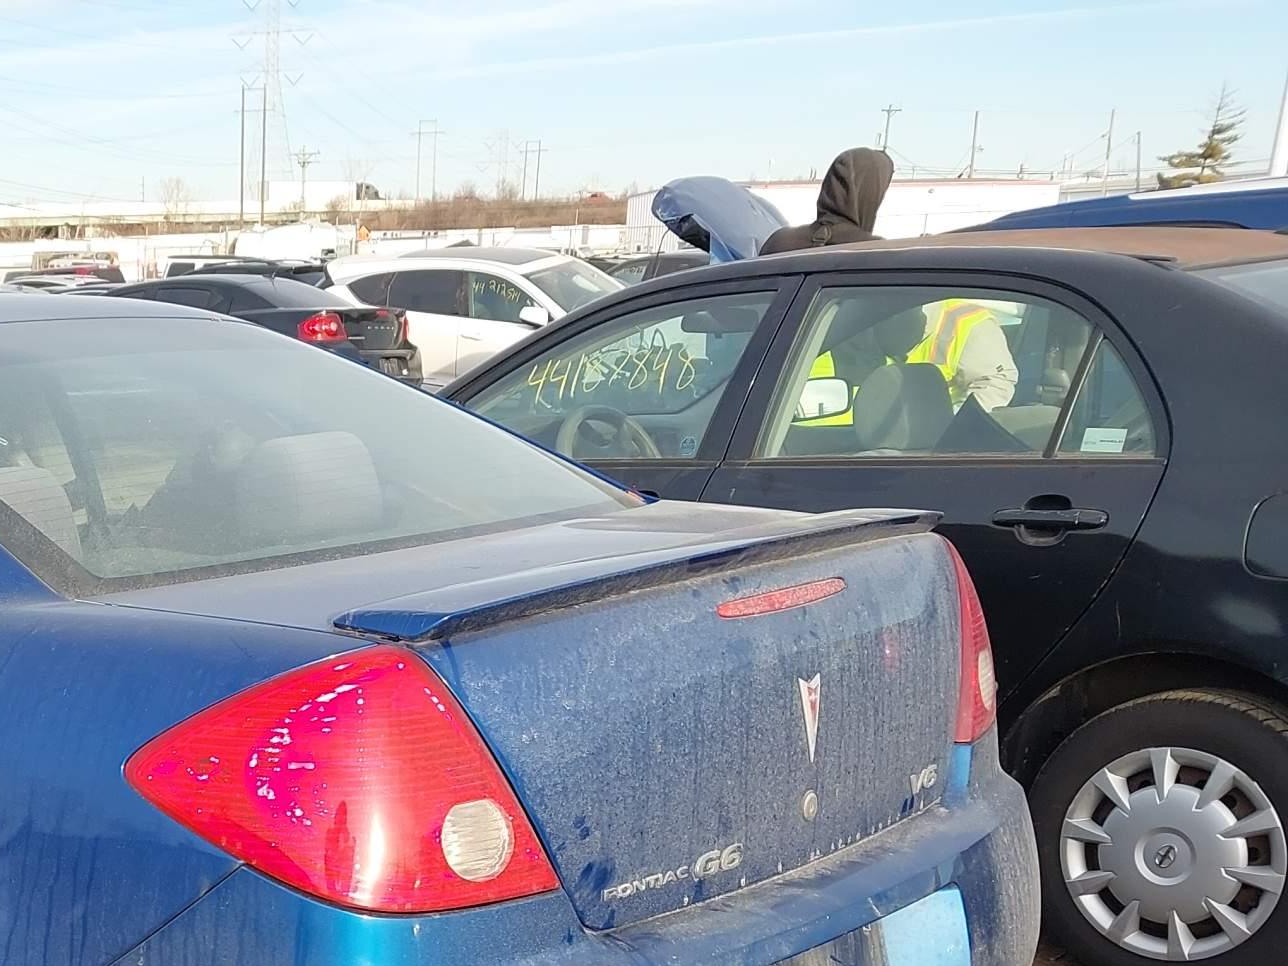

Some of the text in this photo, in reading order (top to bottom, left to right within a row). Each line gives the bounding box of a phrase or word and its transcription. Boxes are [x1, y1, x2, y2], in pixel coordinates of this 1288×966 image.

[909, 763, 938, 795] V6
[601, 842, 744, 902] PONTIAC G6
